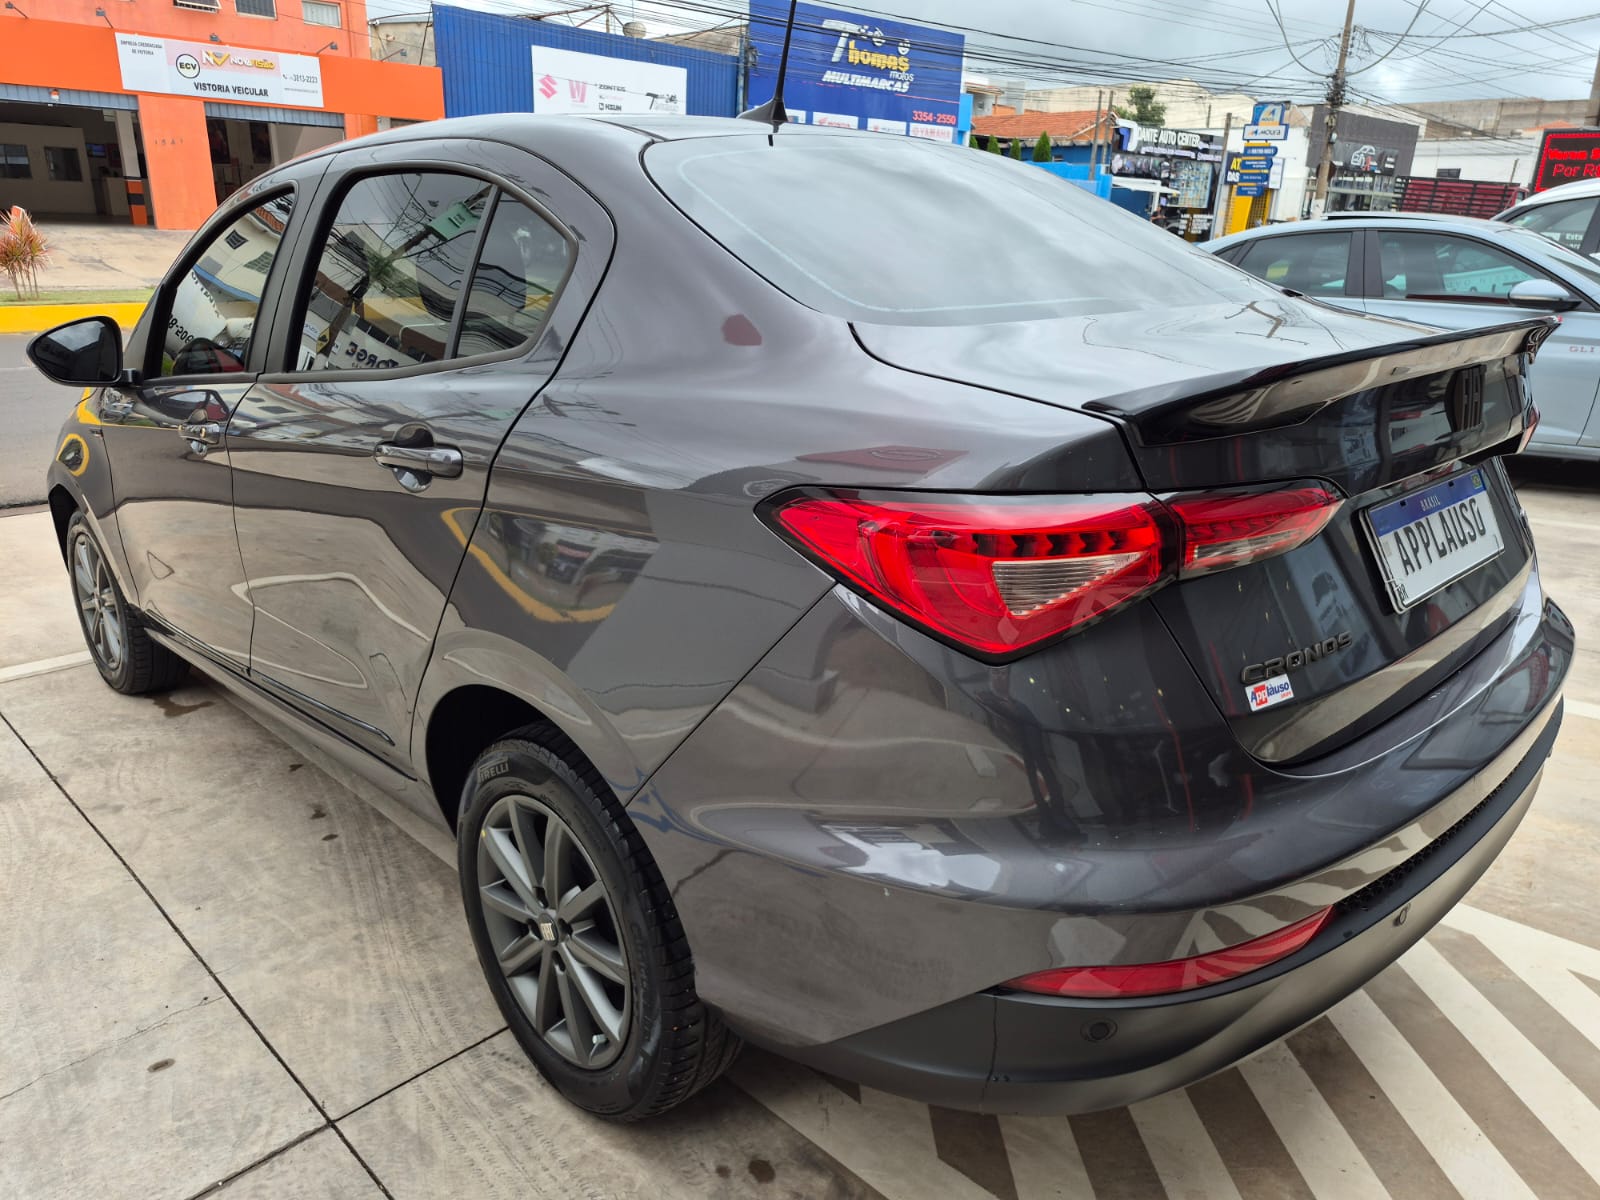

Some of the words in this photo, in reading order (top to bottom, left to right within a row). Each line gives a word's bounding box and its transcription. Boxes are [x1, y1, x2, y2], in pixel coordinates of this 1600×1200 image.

[179, 62, 197, 70] ECV
[821, 70, 910, 93] MULTIMARCAS
[889, 70, 914, 81] motos
[193, 82, 230, 93] VISTORIA
[231, 85, 269, 97] VEICULAR
[1159, 129, 1177, 146] AUTO
[1178, 131, 1200, 147] CENTER
[1553, 163, 1580, 177] Por
[1393, 498, 1487, 577] APPLAUSO
[1241, 630, 1353, 683] CRONOS
[477, 756, 510, 783] PIRELLI
